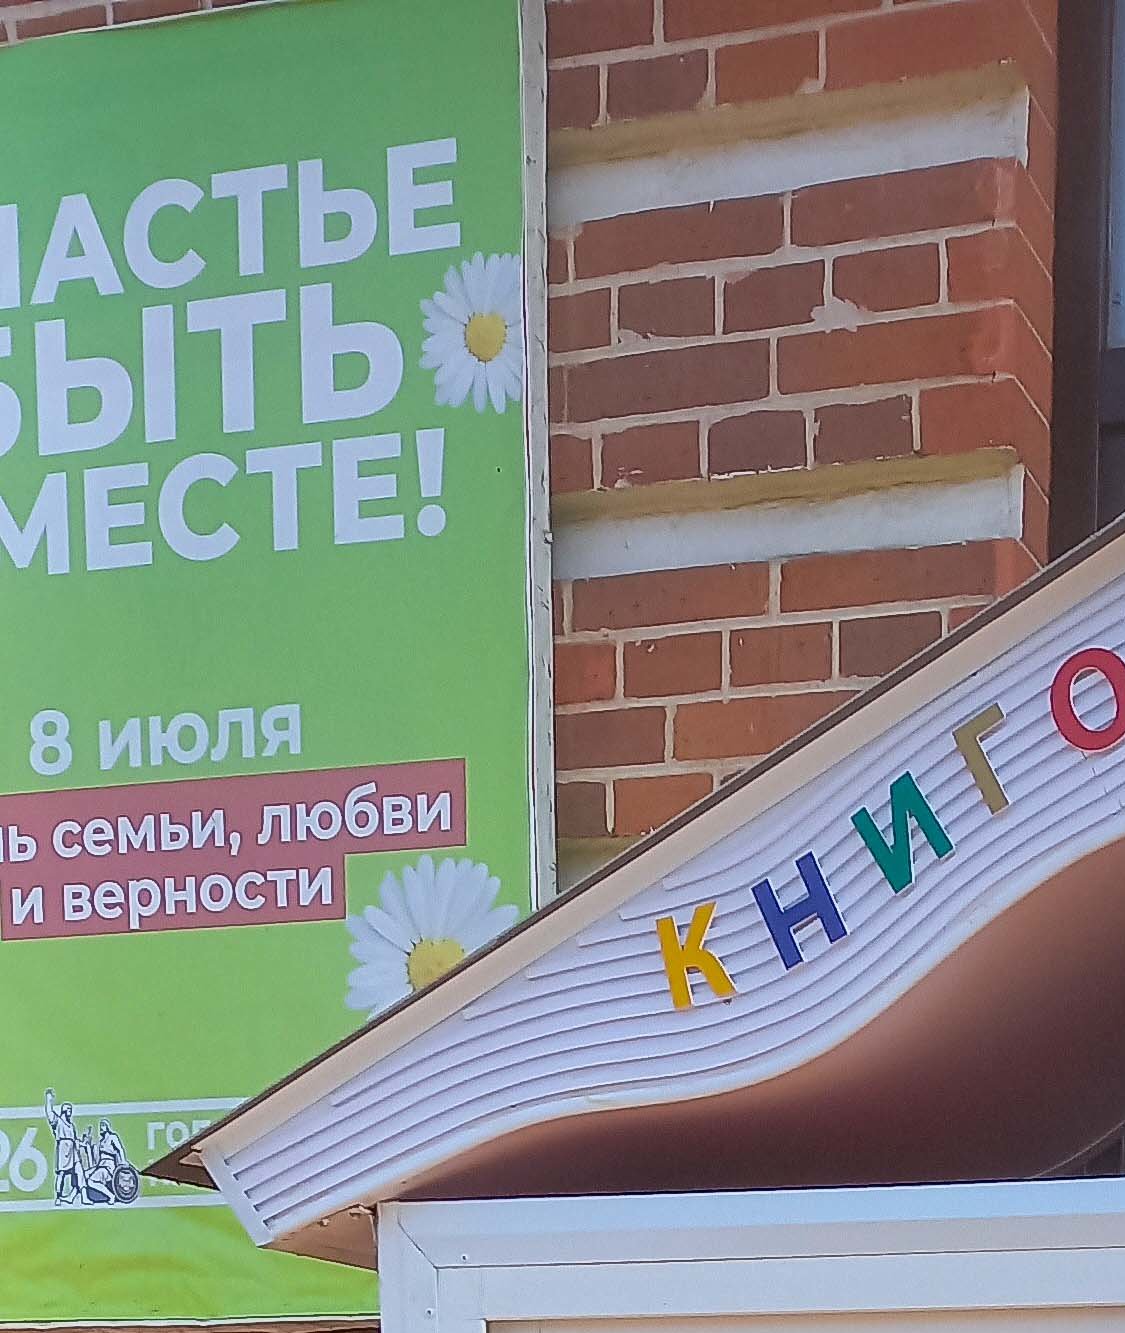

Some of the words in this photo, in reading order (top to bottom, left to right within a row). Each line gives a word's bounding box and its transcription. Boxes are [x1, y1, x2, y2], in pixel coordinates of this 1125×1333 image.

[0, 137, 461, 308] АСТЬЕ
[0, 282, 404, 458] ЫТЬ
[28, 708, 73, 776] 8
[99, 703, 301, 771] июля
[0, 824, 37, 863] ь
[52, 808, 241, 857] семьи,
[257, 781, 452, 846] любви
[11, 886, 44, 925] и
[63, 865, 333, 930] верности
[0, 1127, 48, 1192] 6
